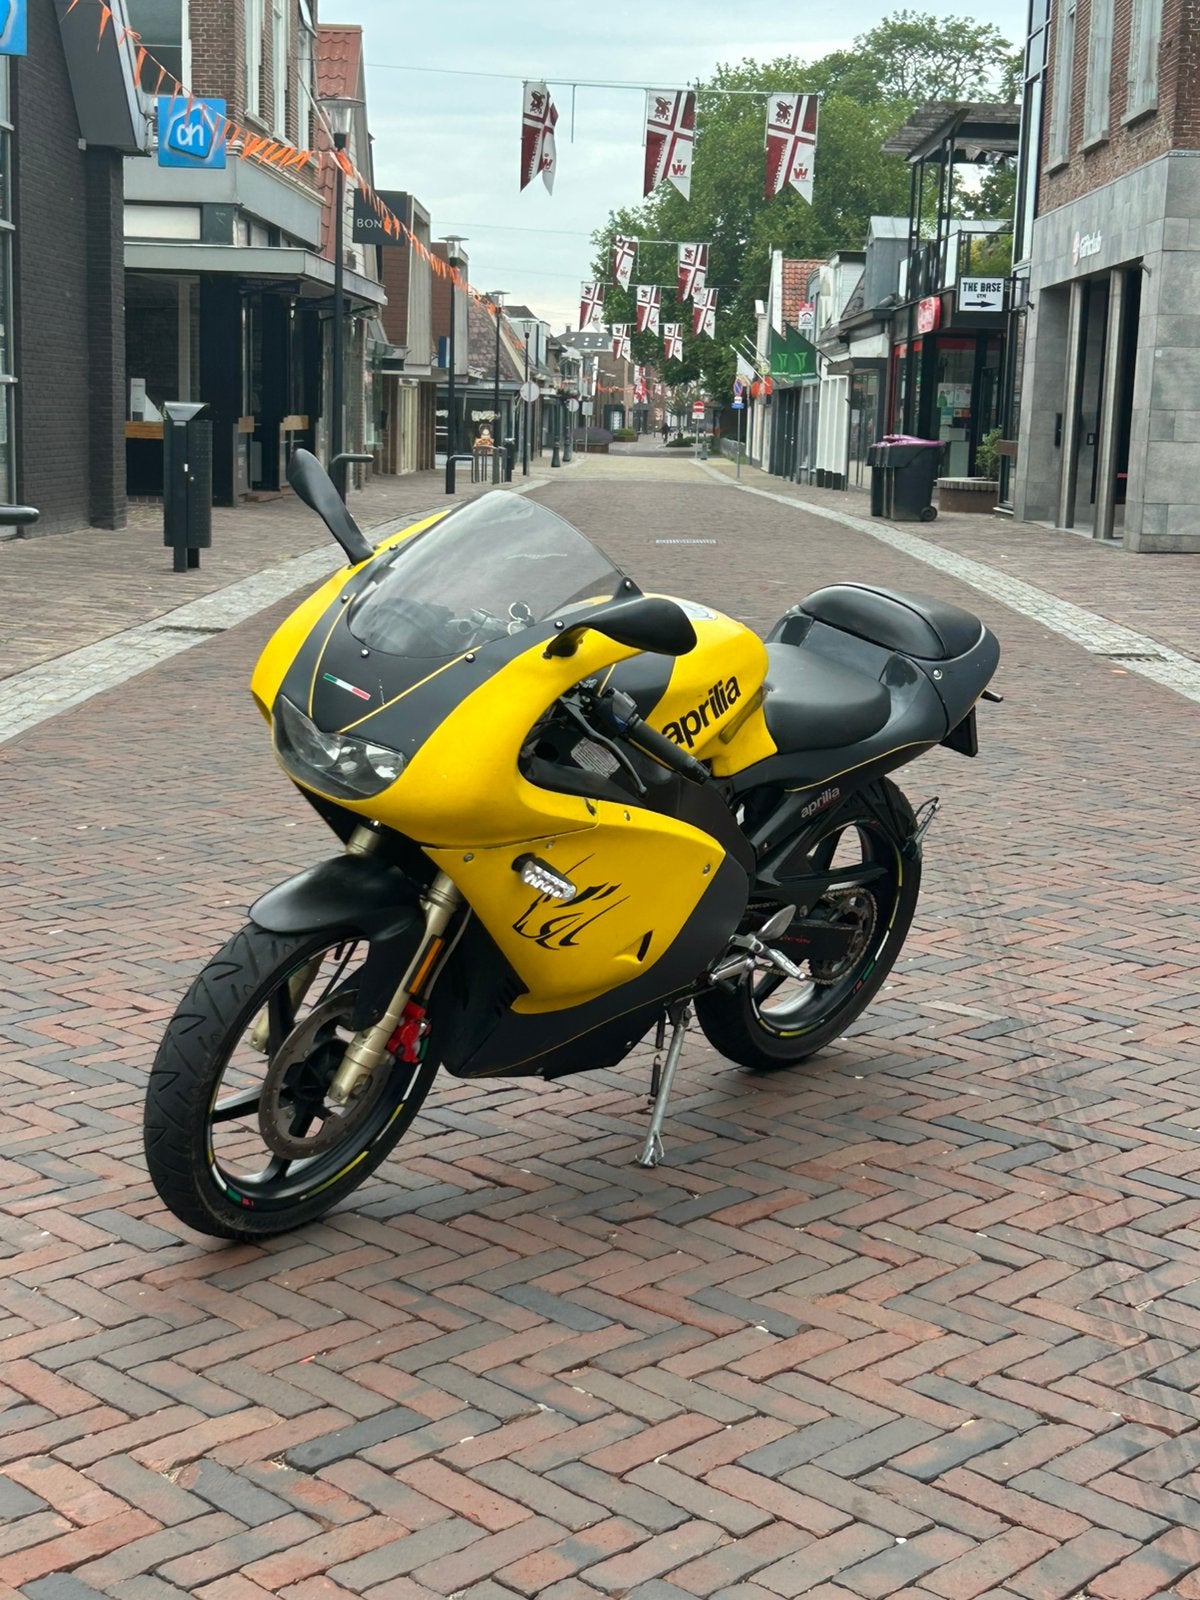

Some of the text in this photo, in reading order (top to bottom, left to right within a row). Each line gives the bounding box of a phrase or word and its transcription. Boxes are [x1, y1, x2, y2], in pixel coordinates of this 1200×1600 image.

[963, 282, 1002, 292] THE BASE
[661, 675, 742, 749] aprilia
[800, 787, 840, 818] aprilia
